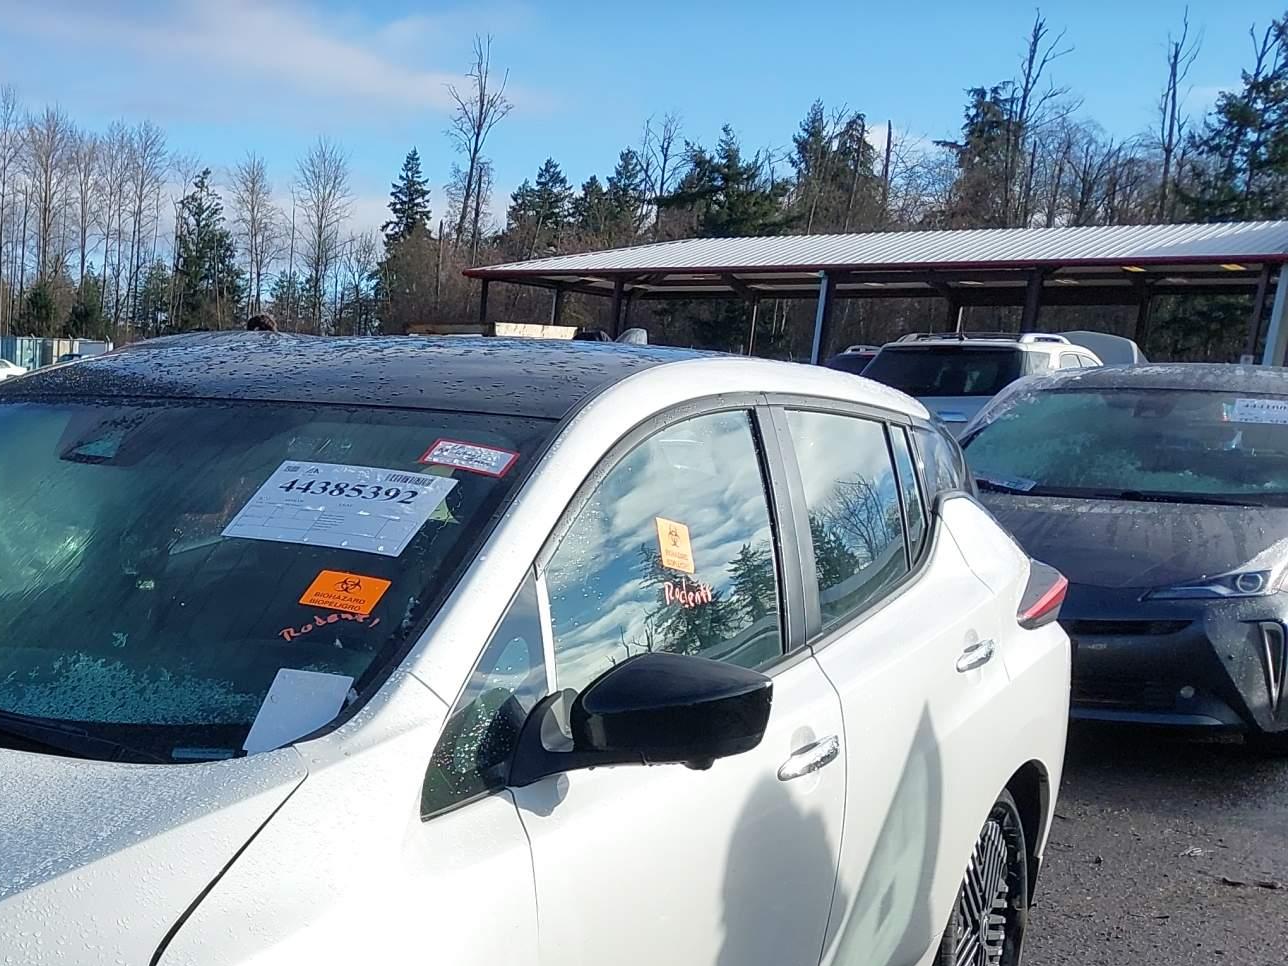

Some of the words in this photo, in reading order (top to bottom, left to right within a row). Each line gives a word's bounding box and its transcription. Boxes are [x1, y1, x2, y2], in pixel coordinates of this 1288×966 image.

[278, 478, 419, 505] 44385392
[313, 591, 366, 605] BIOHAZARD
[308, 599, 361, 612] BIOPELIGRO
